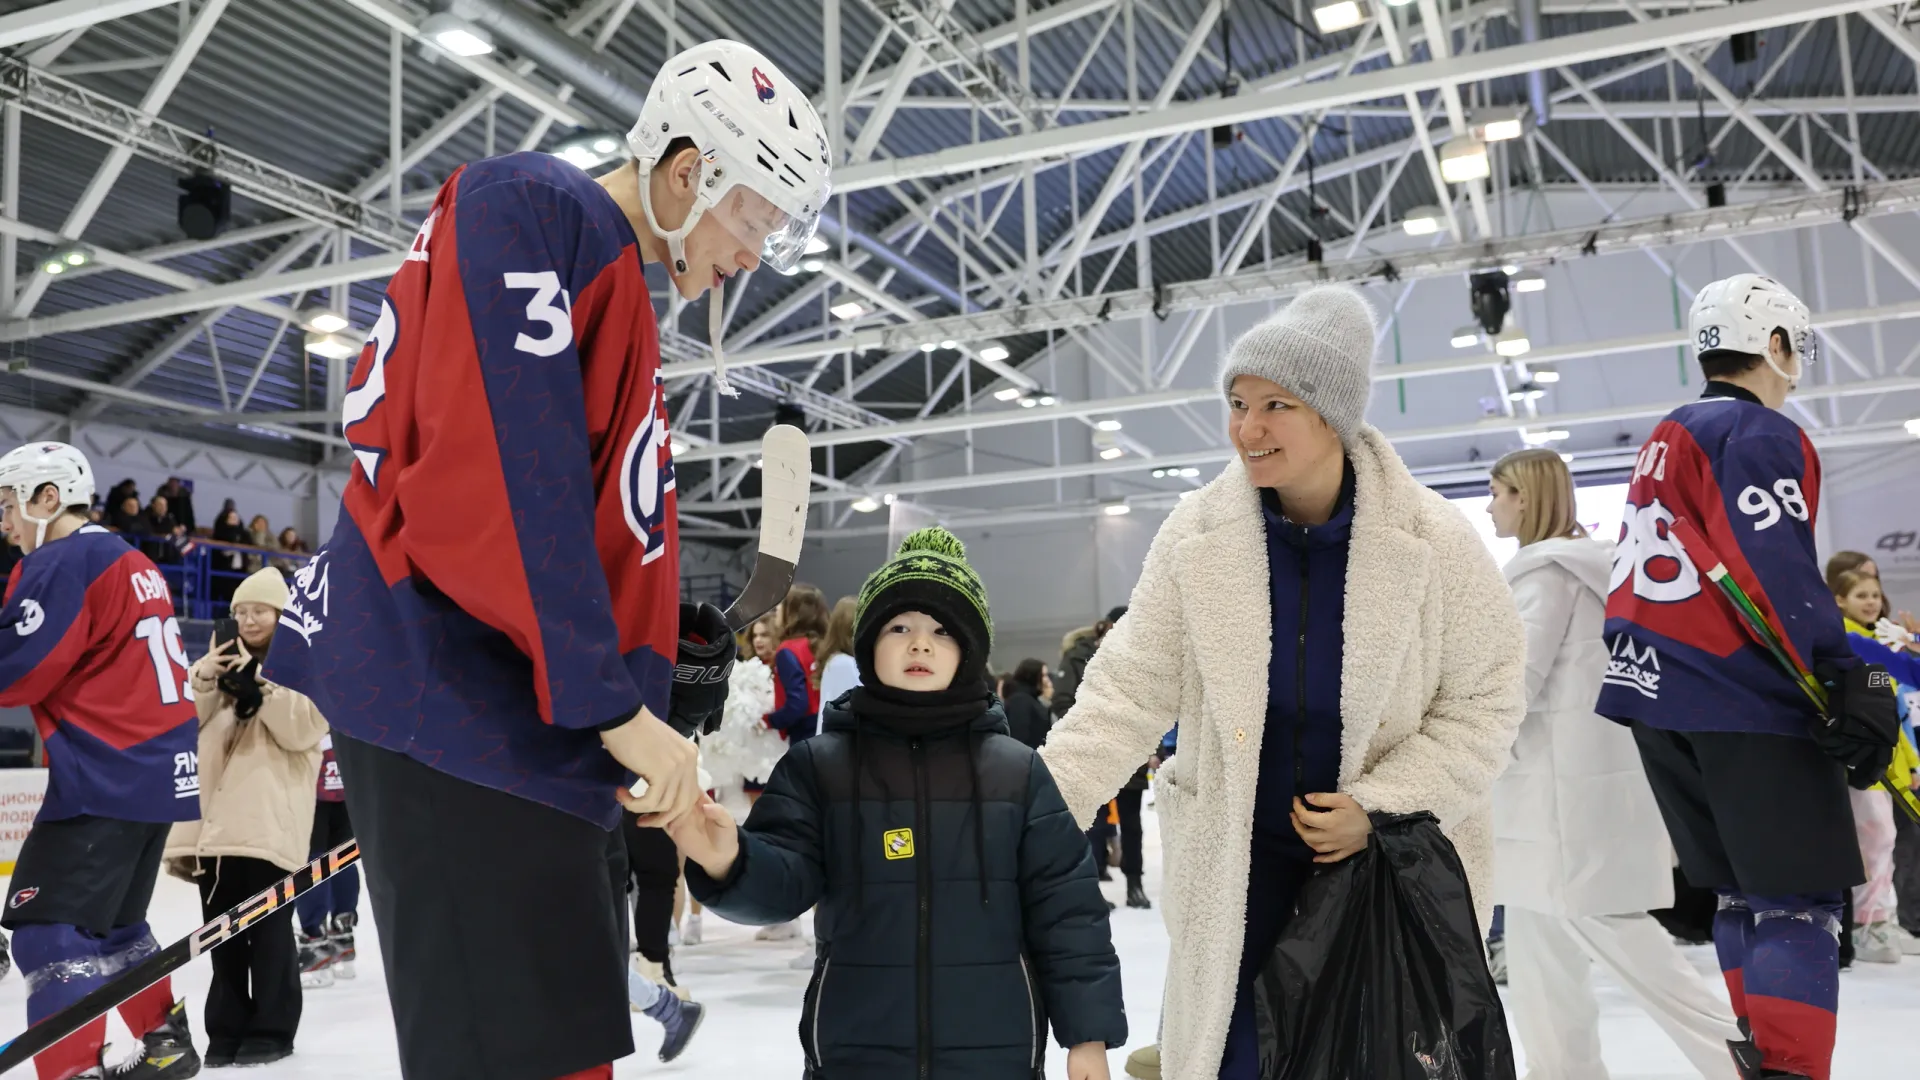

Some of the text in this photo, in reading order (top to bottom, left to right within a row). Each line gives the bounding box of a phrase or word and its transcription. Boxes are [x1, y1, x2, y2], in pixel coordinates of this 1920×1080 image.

[700, 99, 745, 138] BAUER
[503, 270, 573, 357] 3
[1698, 325, 1721, 352] 98
[1737, 478, 1809, 531] 98
[1876, 530, 1920, 552] Ф
